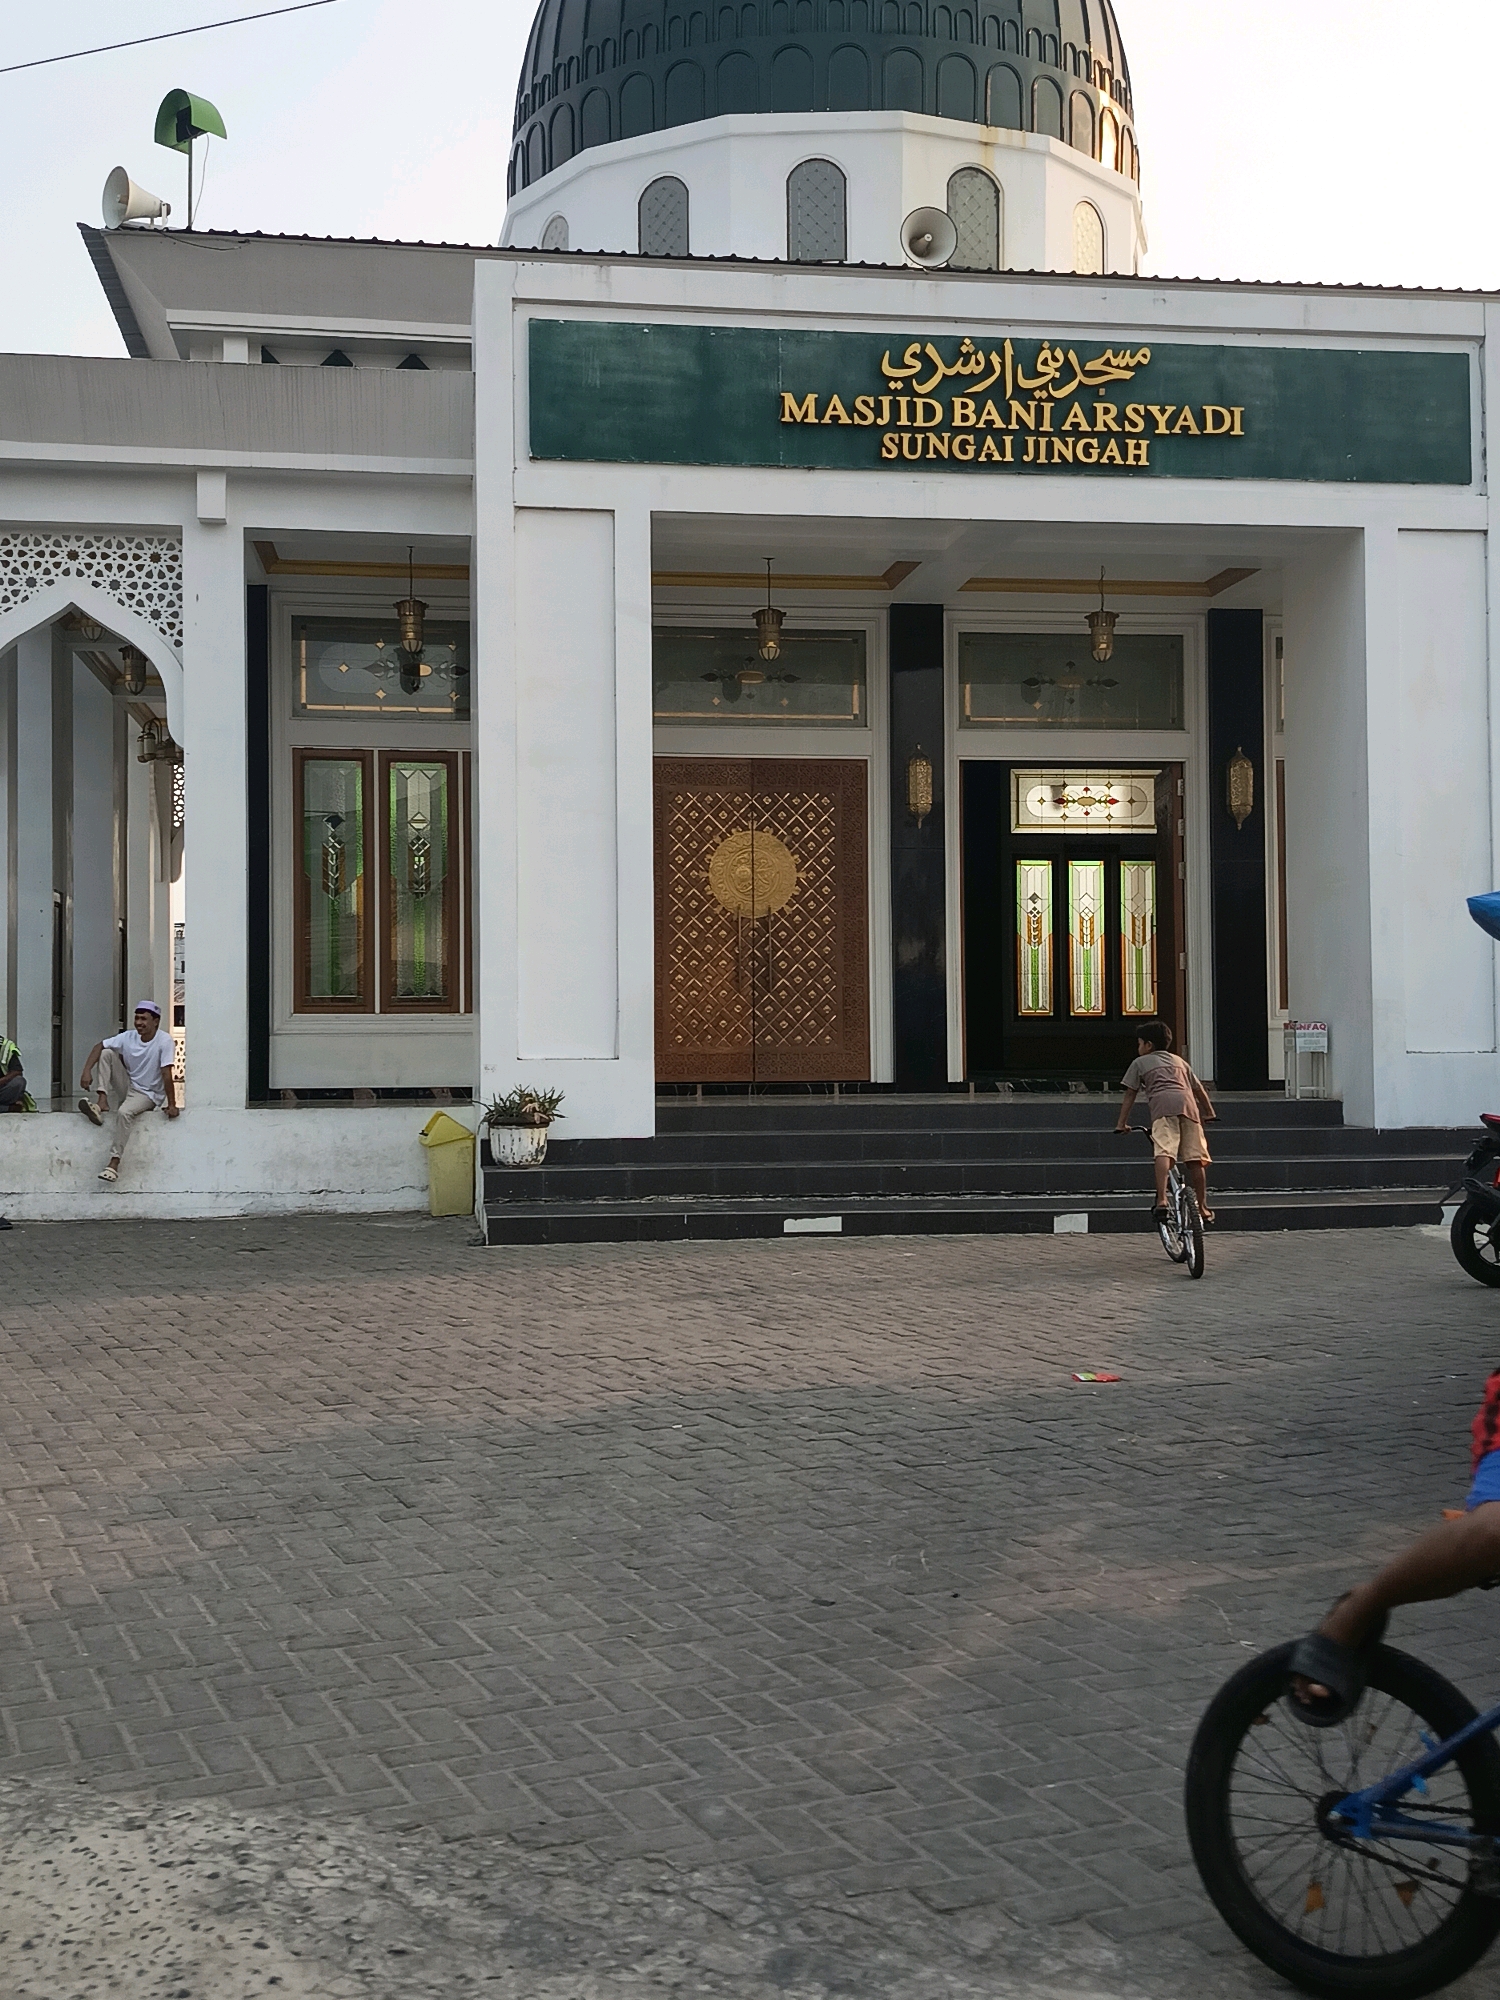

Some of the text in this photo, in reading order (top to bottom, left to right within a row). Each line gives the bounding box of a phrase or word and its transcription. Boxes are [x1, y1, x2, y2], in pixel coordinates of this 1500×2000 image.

[882, 337, 1151, 400] مسجد بني ارشدي
[781, 392, 1244, 436] MASJID BANI ARSYADI
[881, 432, 1150, 466] SUNGAI JINGAH
